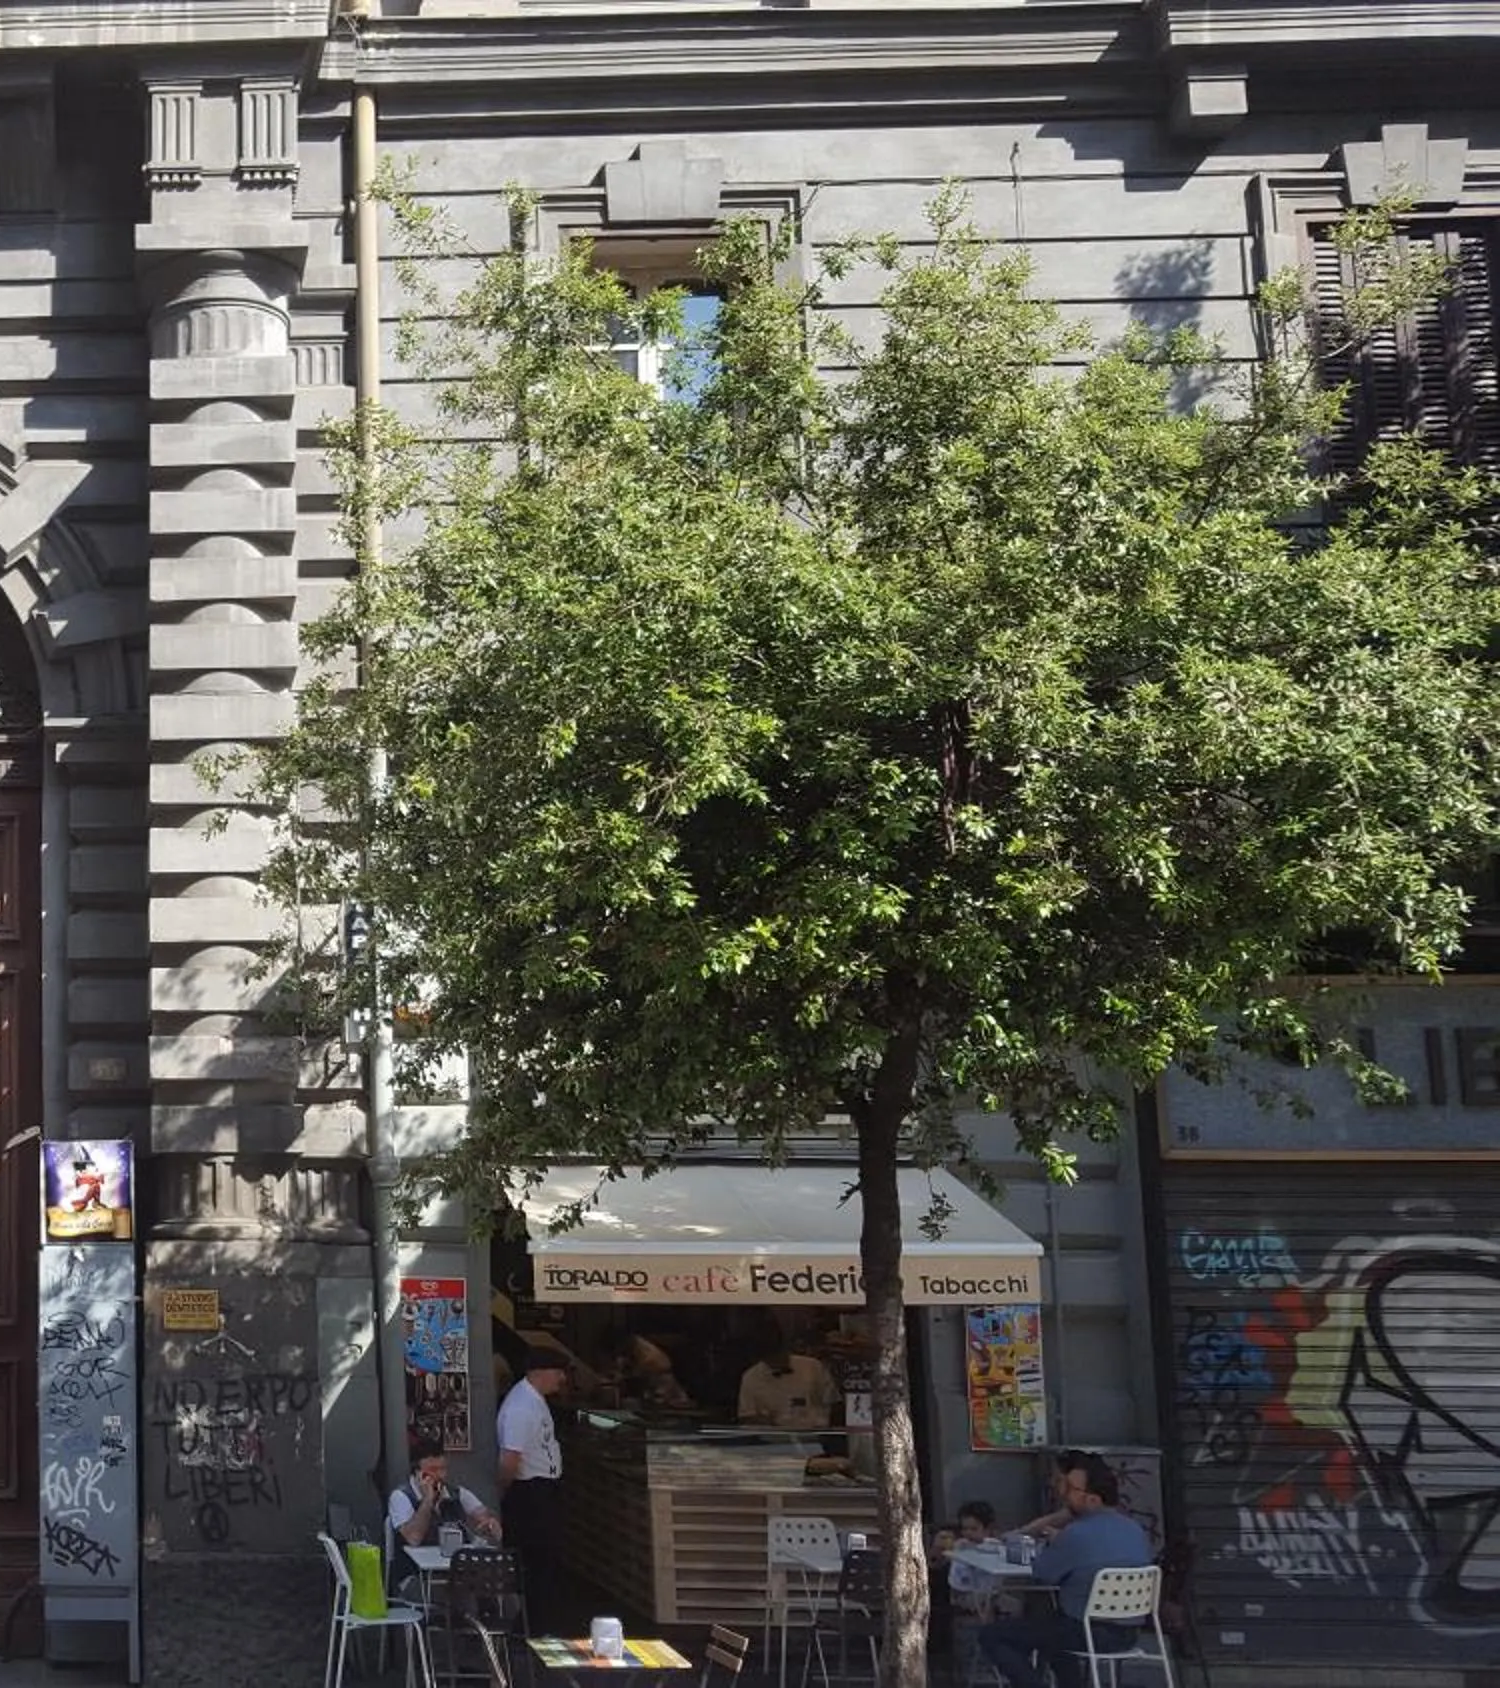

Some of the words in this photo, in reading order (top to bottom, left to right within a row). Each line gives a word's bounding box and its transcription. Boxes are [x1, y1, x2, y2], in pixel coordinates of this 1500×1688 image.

[544, 1268, 649, 1285] TORALDO
[751, 1265, 903, 1294] Federi
[919, 1275, 1029, 1294] Tabacchi
